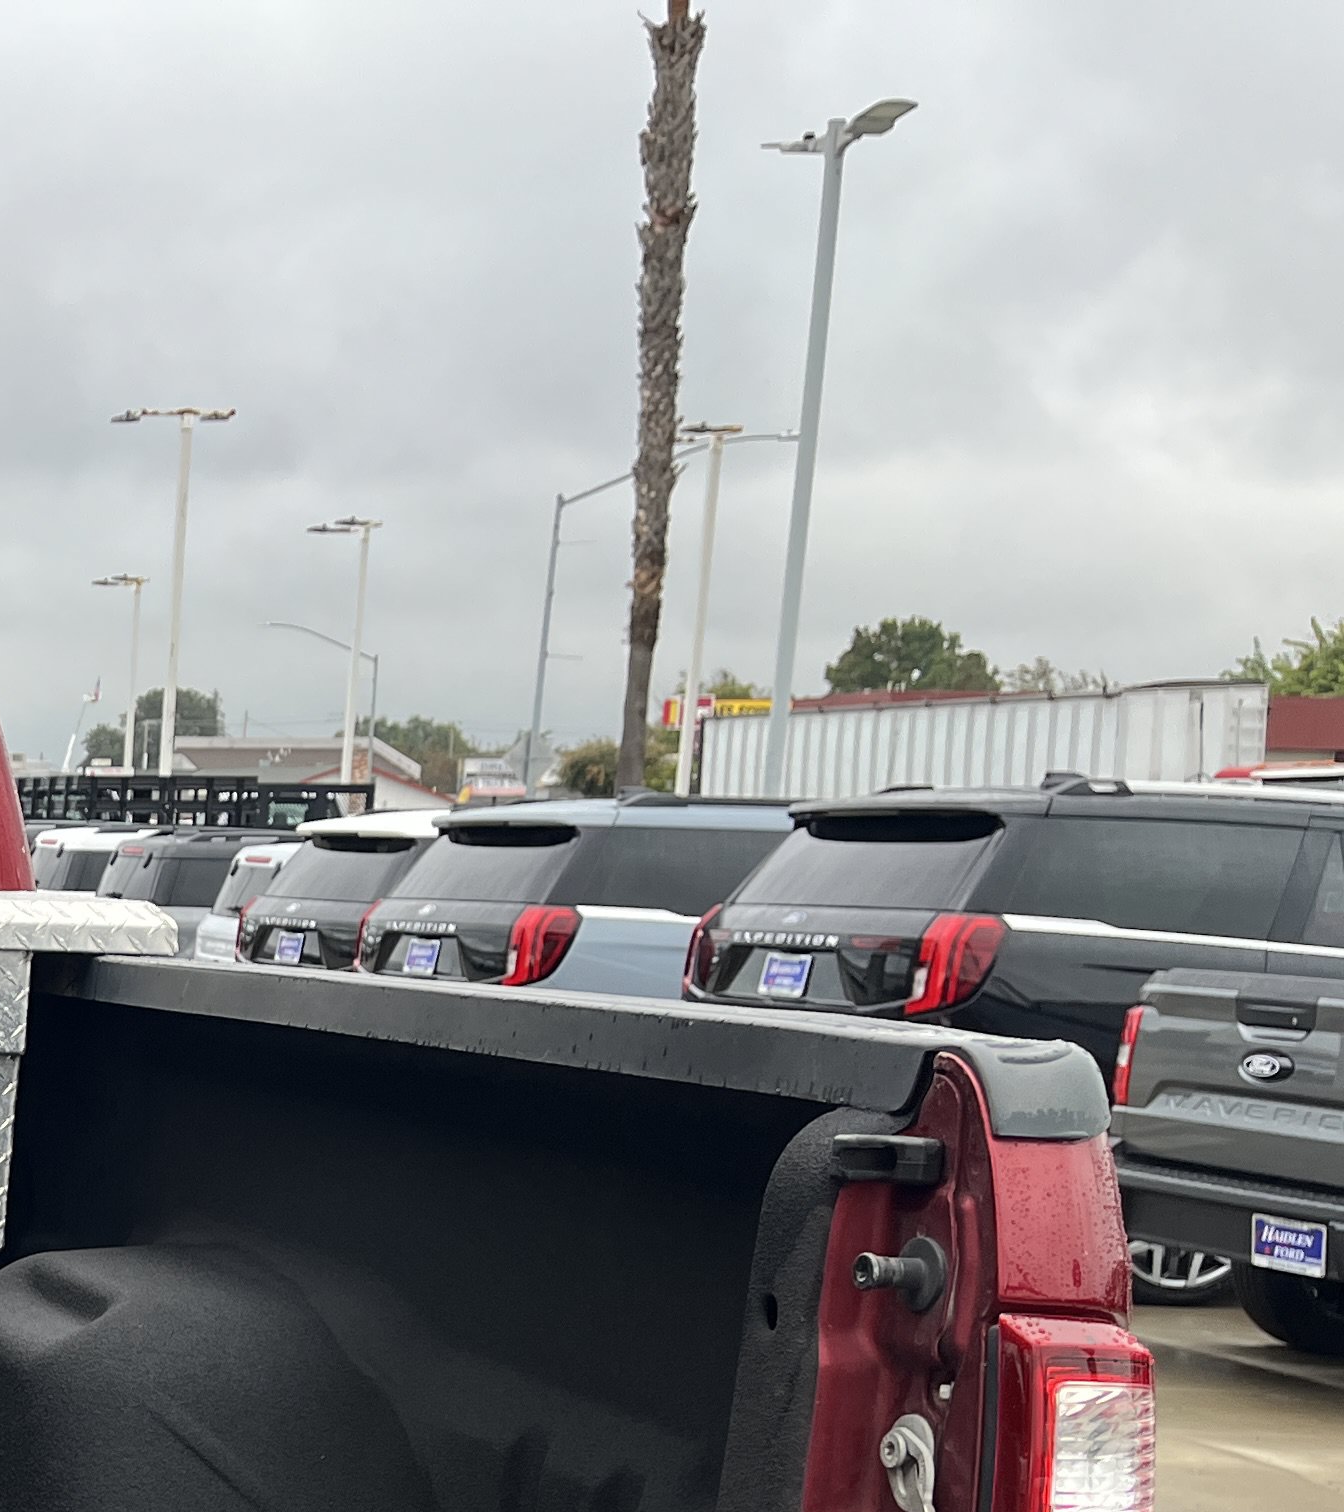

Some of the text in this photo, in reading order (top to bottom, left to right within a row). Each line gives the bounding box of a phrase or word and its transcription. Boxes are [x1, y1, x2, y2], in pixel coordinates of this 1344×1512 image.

[385, 921, 457, 933] EXPEDITION
[733, 931, 839, 947] EXPEDITION
[1274, 1245, 1305, 1262] FORD
